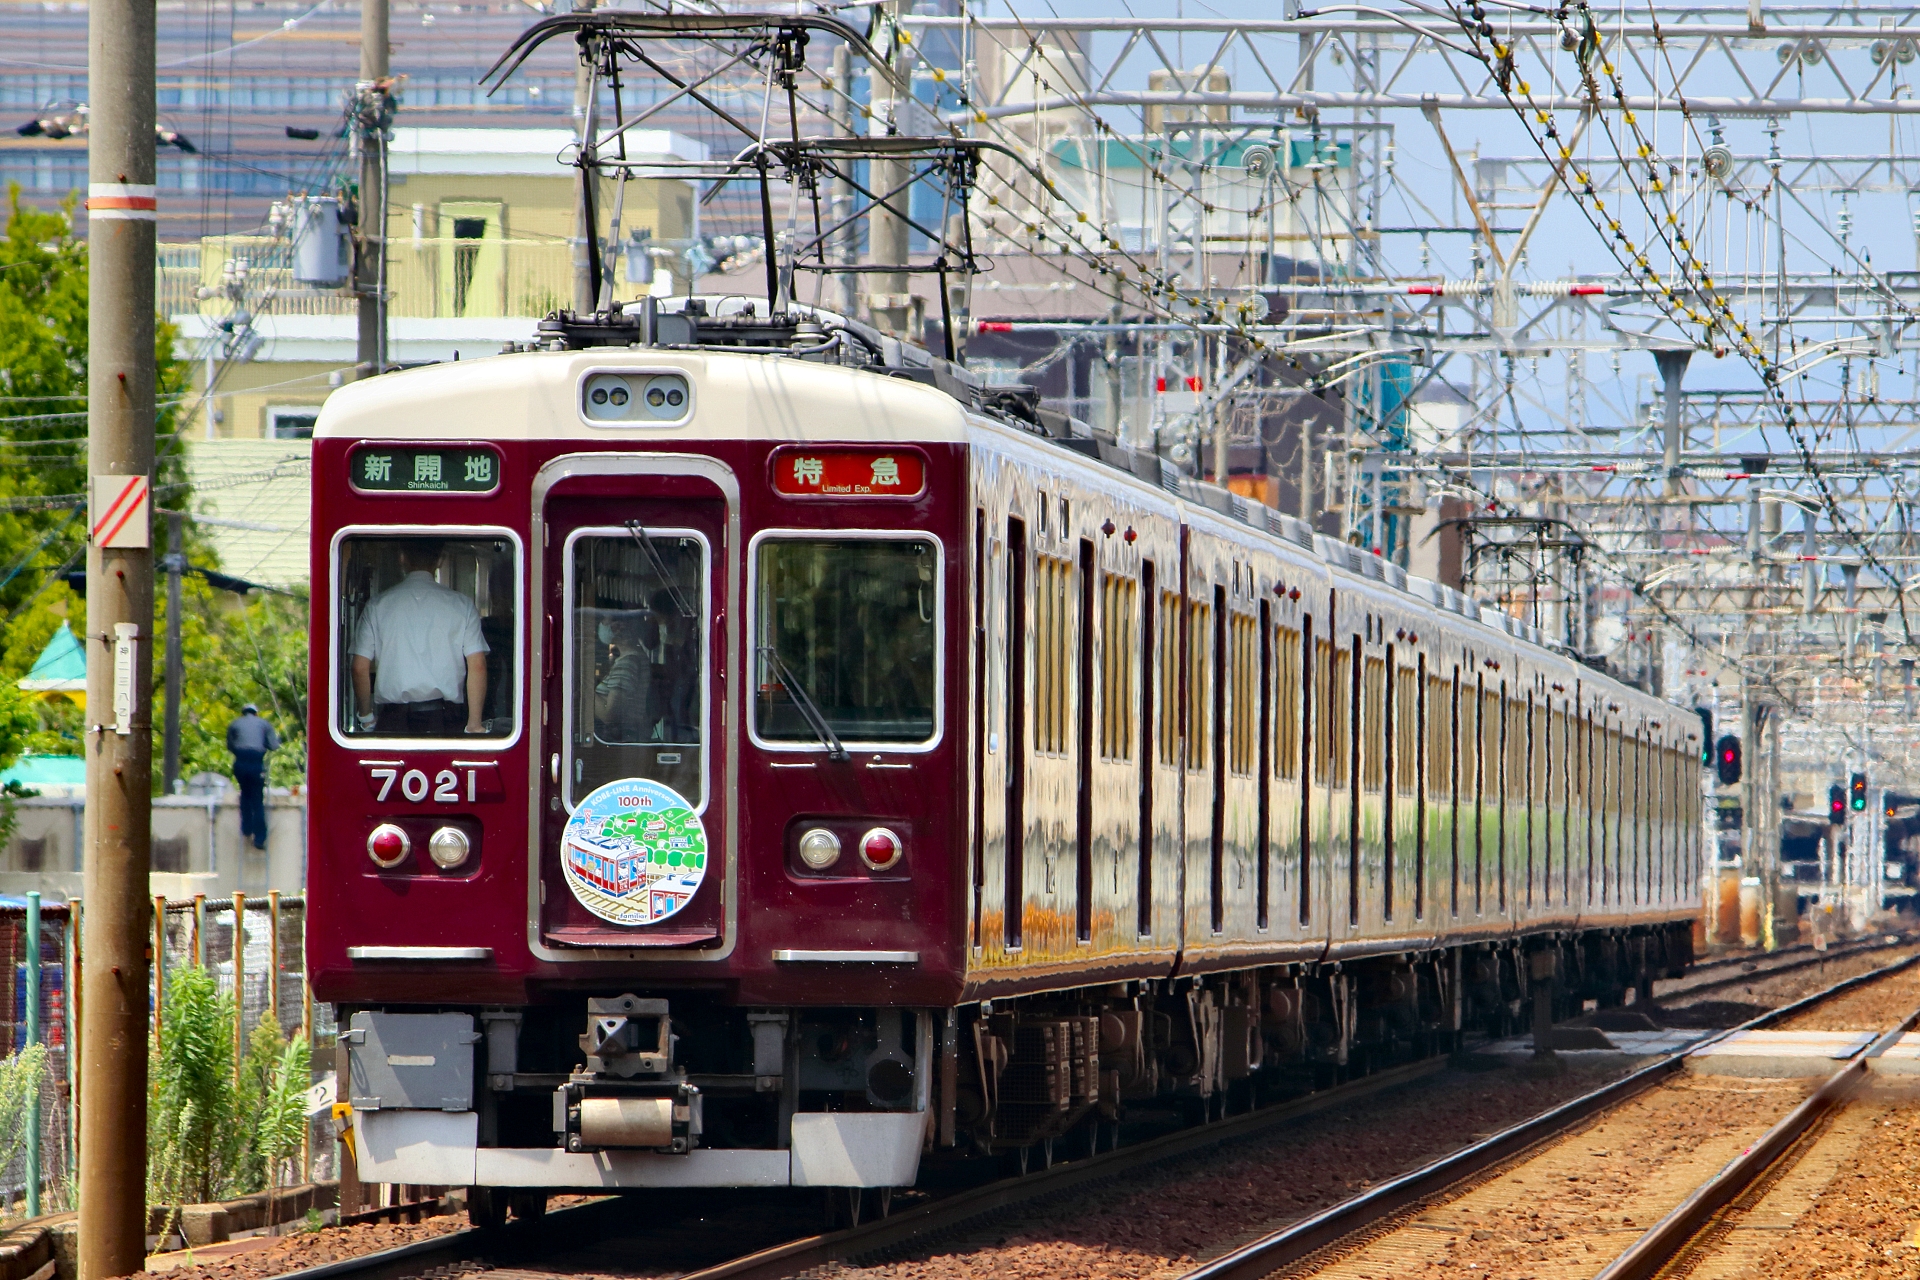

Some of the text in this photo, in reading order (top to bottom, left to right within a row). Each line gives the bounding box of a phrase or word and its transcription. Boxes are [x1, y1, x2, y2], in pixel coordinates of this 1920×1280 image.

[364, 454, 492, 482] 新開地
[793, 457, 902, 486] 特急
[407, 481, 449, 489] Shinkaichi
[822, 484, 872, 494] Limited Exp.
[371, 768, 477, 802] 7021
[590, 785, 678, 807] KOBE-LINE Anniversary
[617, 795, 653, 807] 100th
[619, 912, 648, 920] familiar
